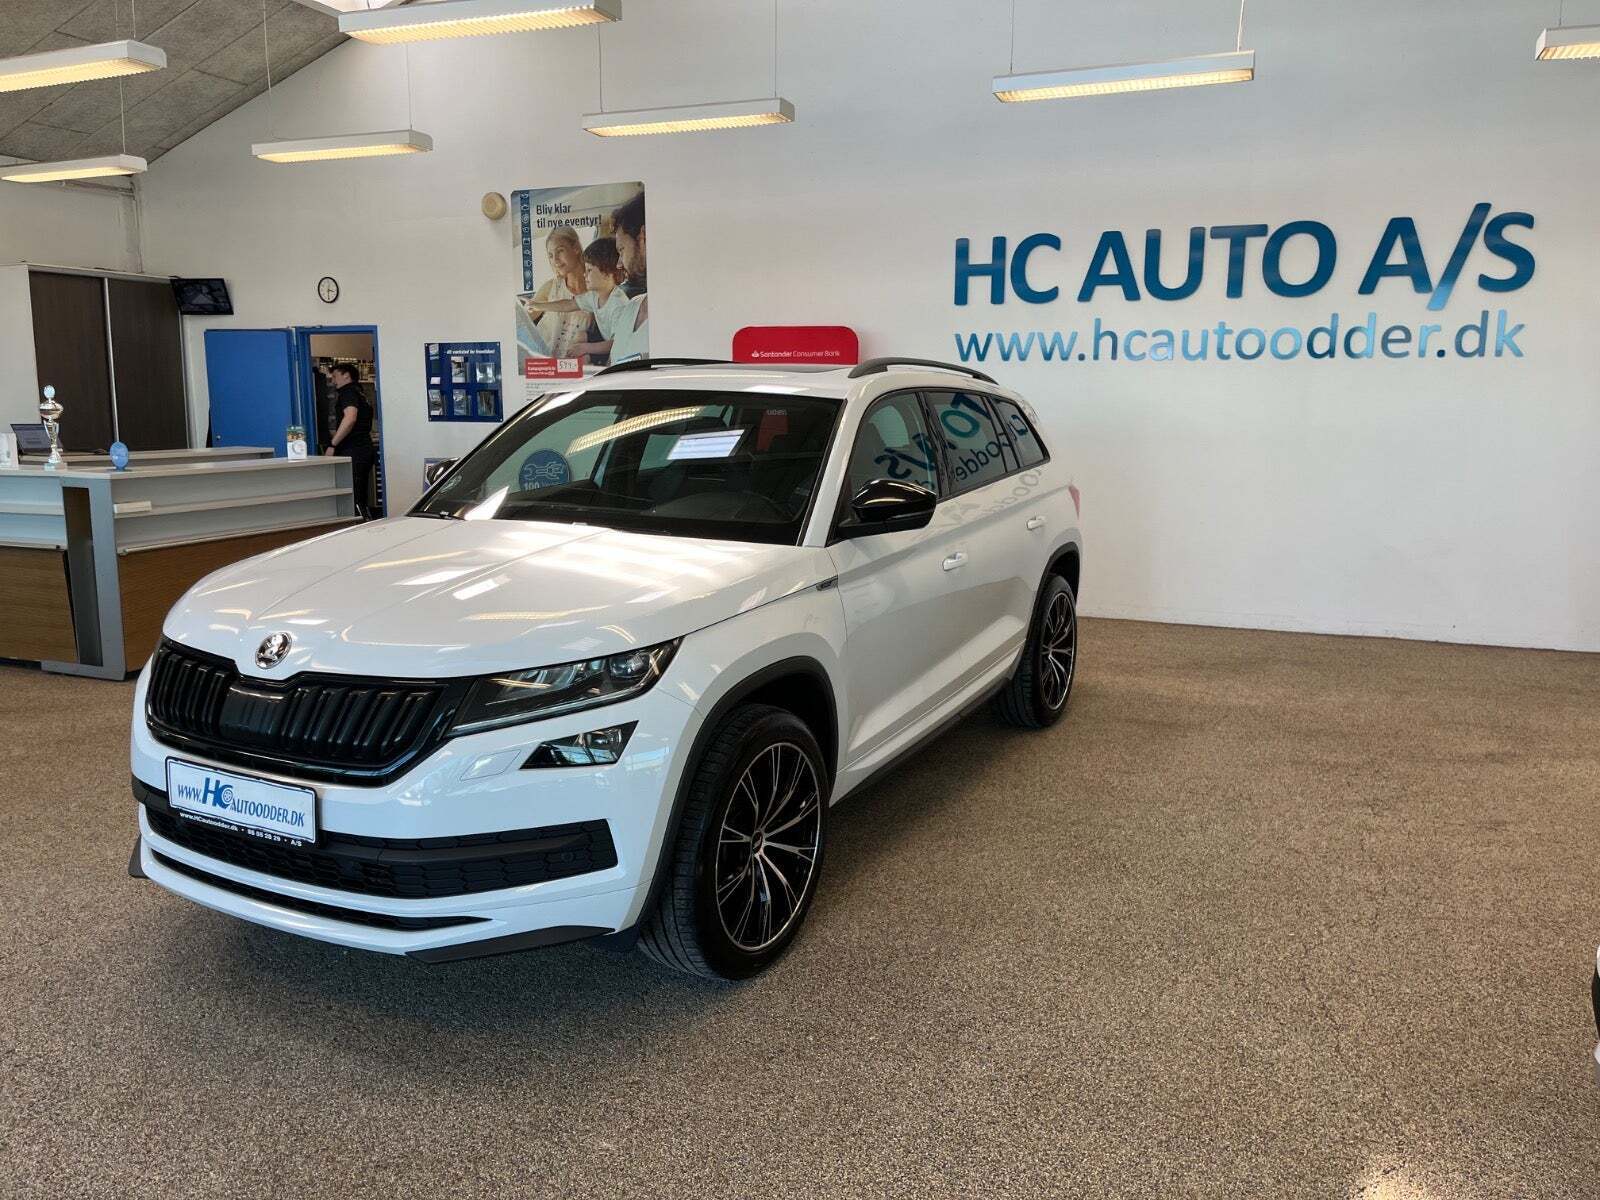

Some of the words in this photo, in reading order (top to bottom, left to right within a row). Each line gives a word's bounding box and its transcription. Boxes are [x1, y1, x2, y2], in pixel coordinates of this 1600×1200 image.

[536, 204, 553, 216] Bliv
[554, 202, 572, 214] klar
[536, 217, 547, 229] til
[547, 218, 564, 230] nye
[564, 214, 602, 228] eventyr!
[953, 231, 1063, 309] HC
[1075, 219, 1339, 305] AUTO
[1358, 201, 1537, 312] A/S
[953, 307, 1525, 365] www.hcautoodder.dk
[760, 350, 793, 358] Santander
